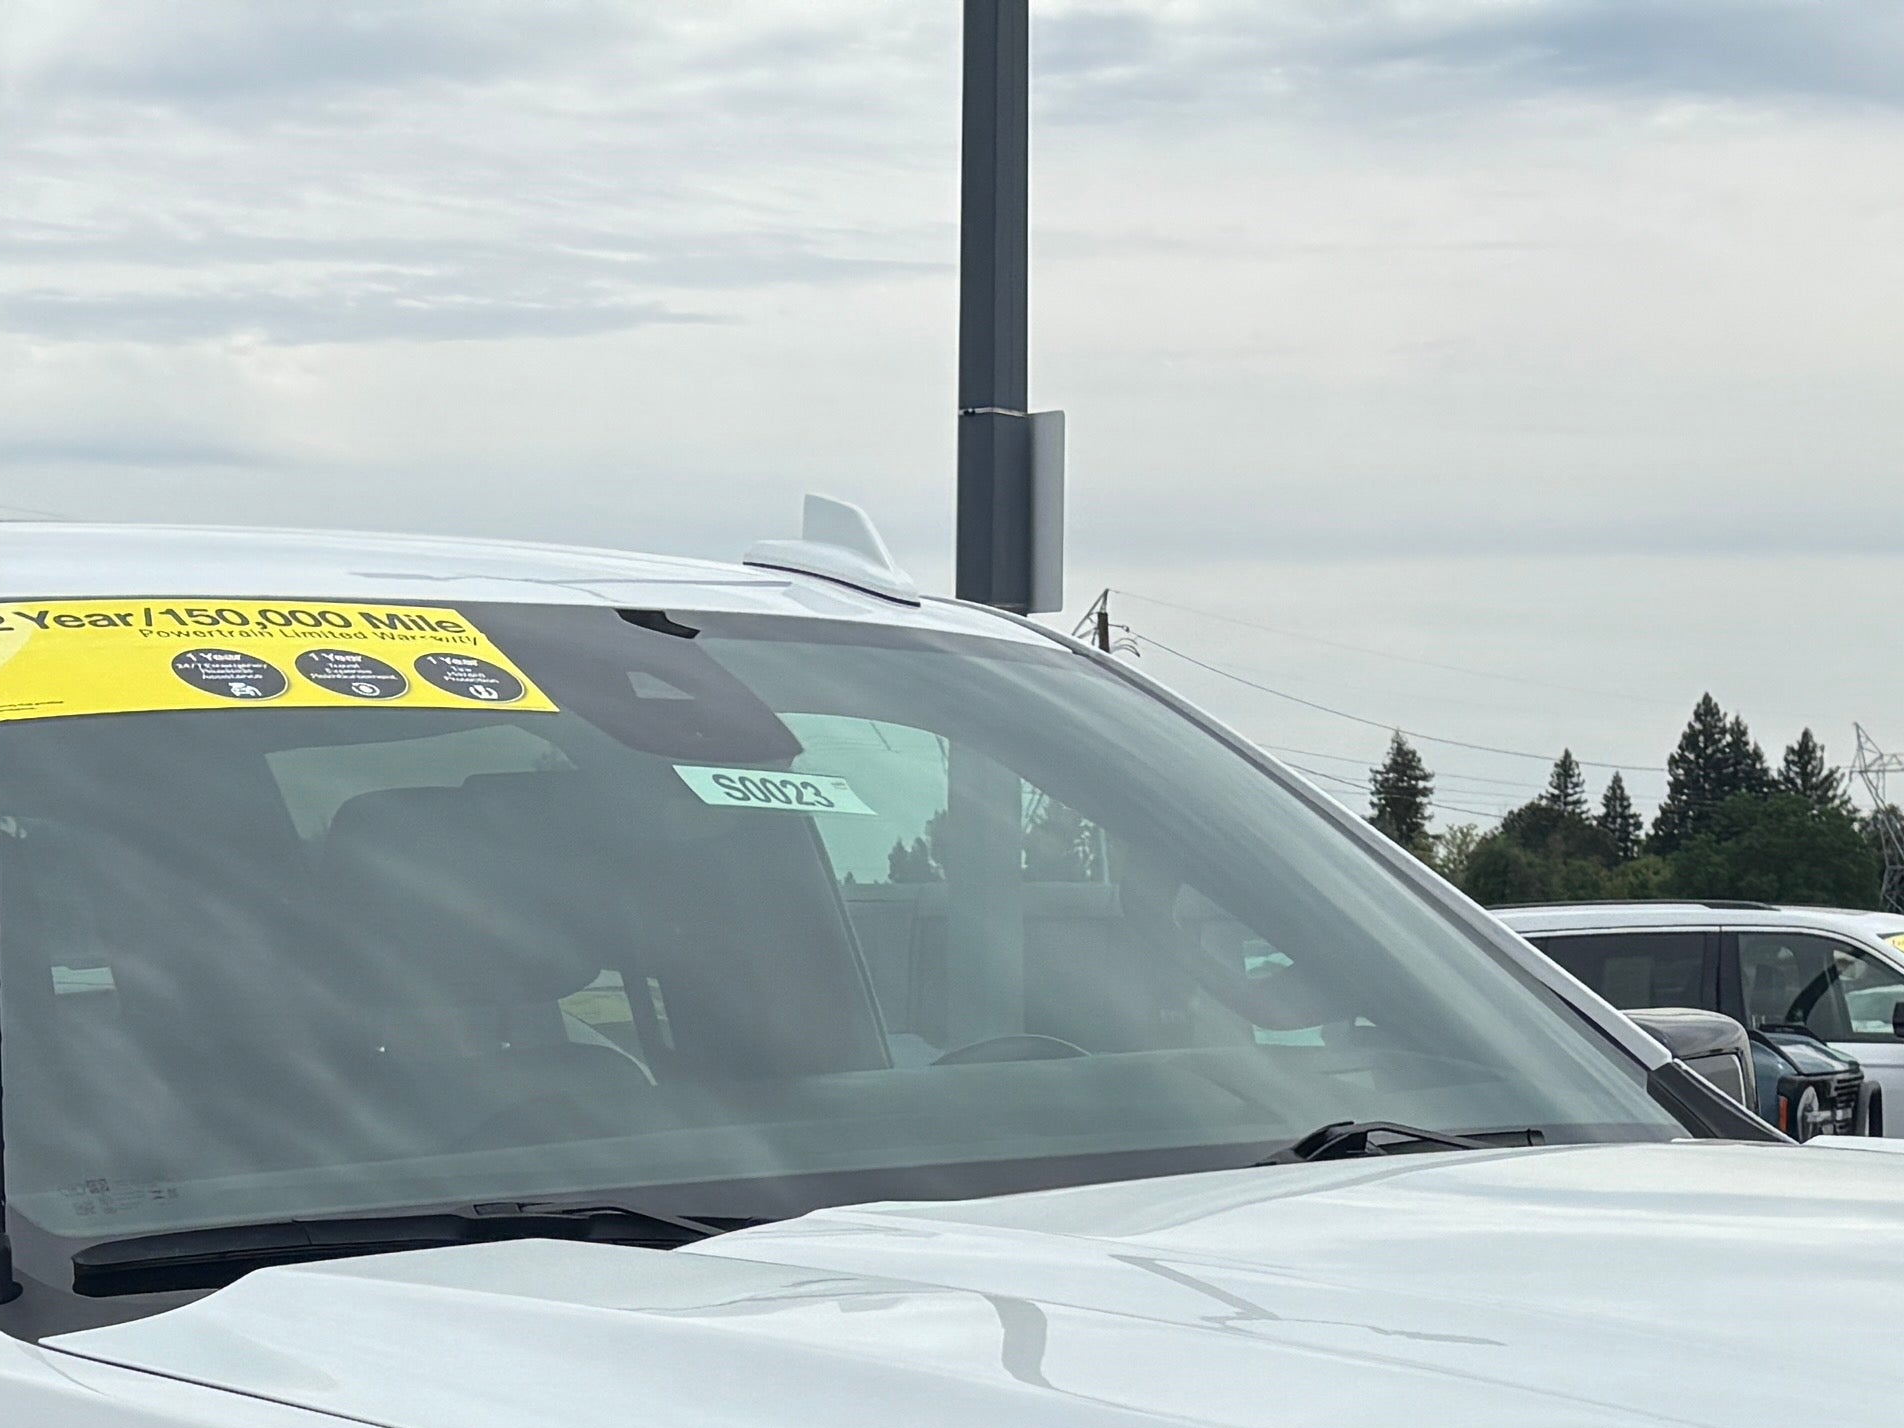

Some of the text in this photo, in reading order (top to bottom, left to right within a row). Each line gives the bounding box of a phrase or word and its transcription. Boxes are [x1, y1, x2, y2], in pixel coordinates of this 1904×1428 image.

[358, 611, 466, 633] Mile
[139, 628, 274, 639] Powertrain
[280, 628, 368, 640] Limited
[200, 653, 242, 661] Year
[712, 773, 834, 808] S0023
